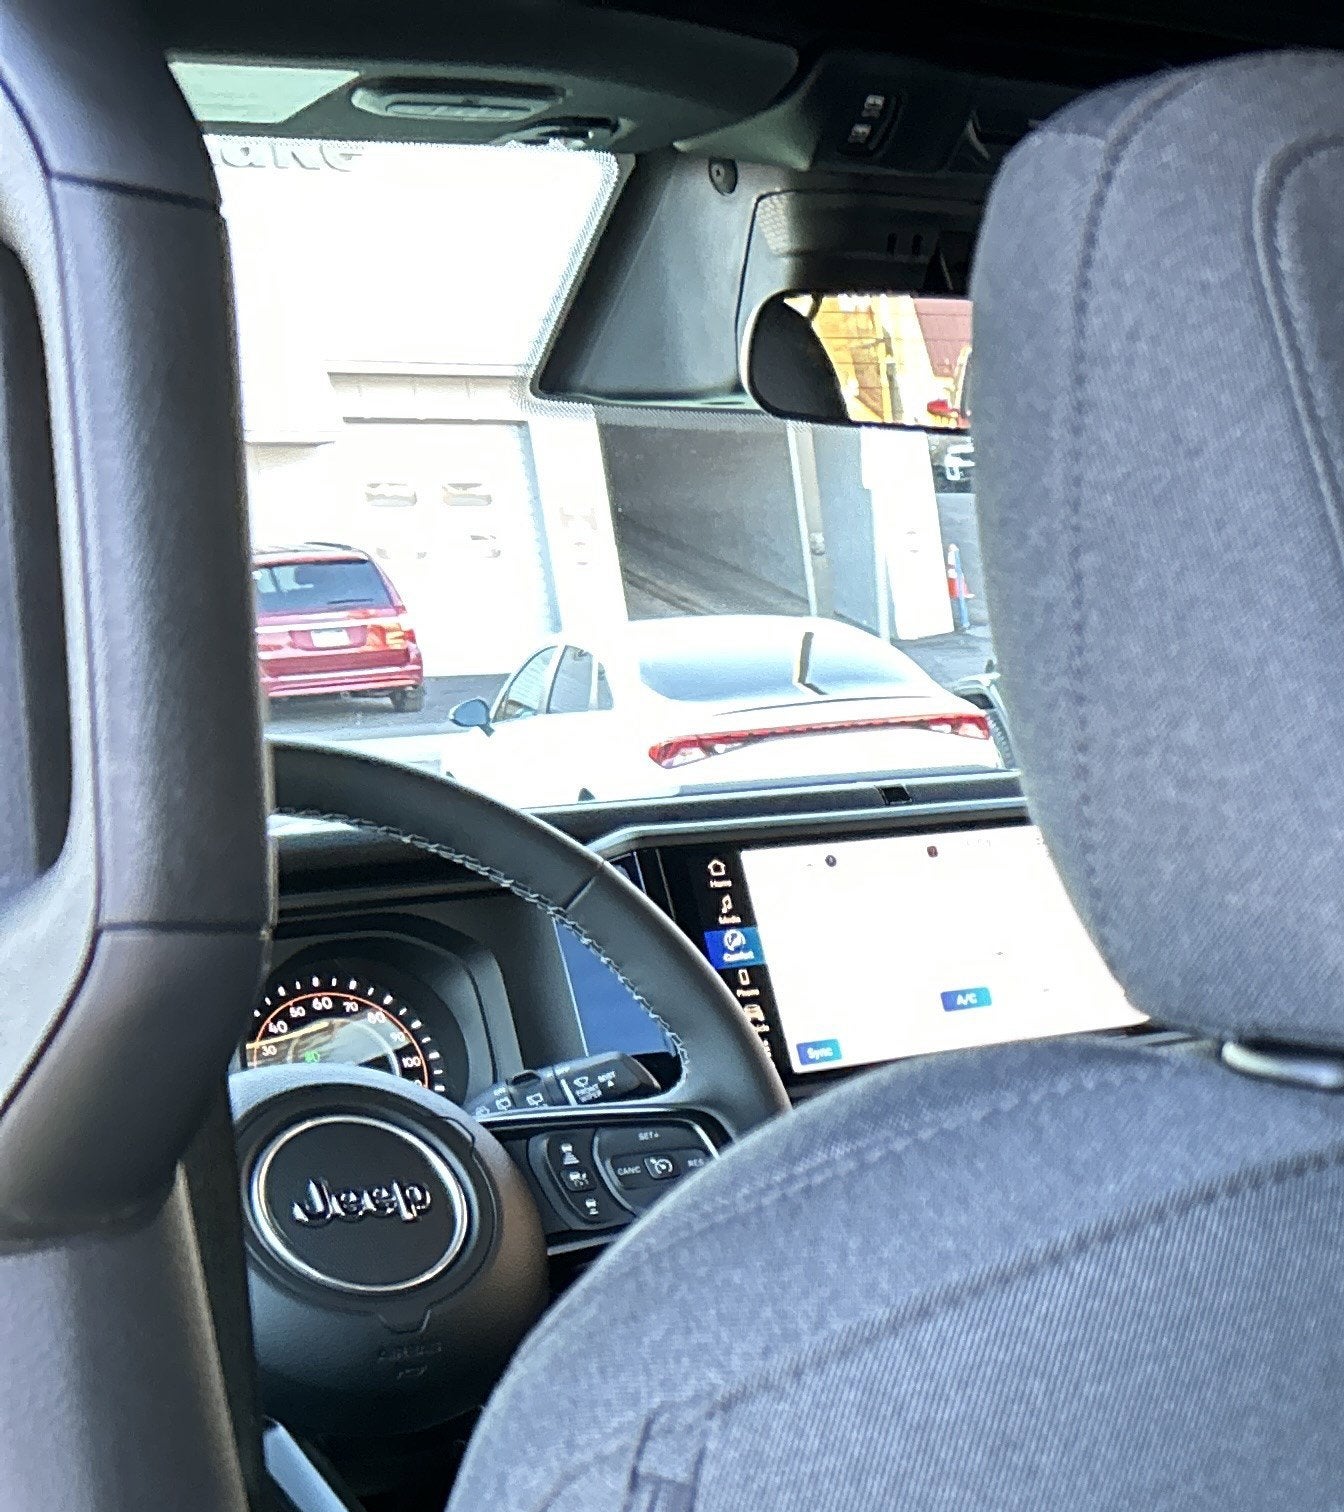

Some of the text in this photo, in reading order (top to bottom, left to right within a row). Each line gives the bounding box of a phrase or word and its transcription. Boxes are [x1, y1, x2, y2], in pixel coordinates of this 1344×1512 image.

[312, 996, 333, 1011] 60
[955, 992, 978, 1006] A/C
[289, 1006, 306, 1018] 50
[343, 1001, 359, 1013] 70
[367, 1010, 386, 1024] 80
[268, 1020, 288, 1034] 40
[390, 1031, 406, 1043] 90
[262, 1045, 277, 1056] 30
[401, 1055, 422, 1068] 100
[617, 1165, 641, 1176] CANC
[292, 1177, 431, 1227] Jeep
